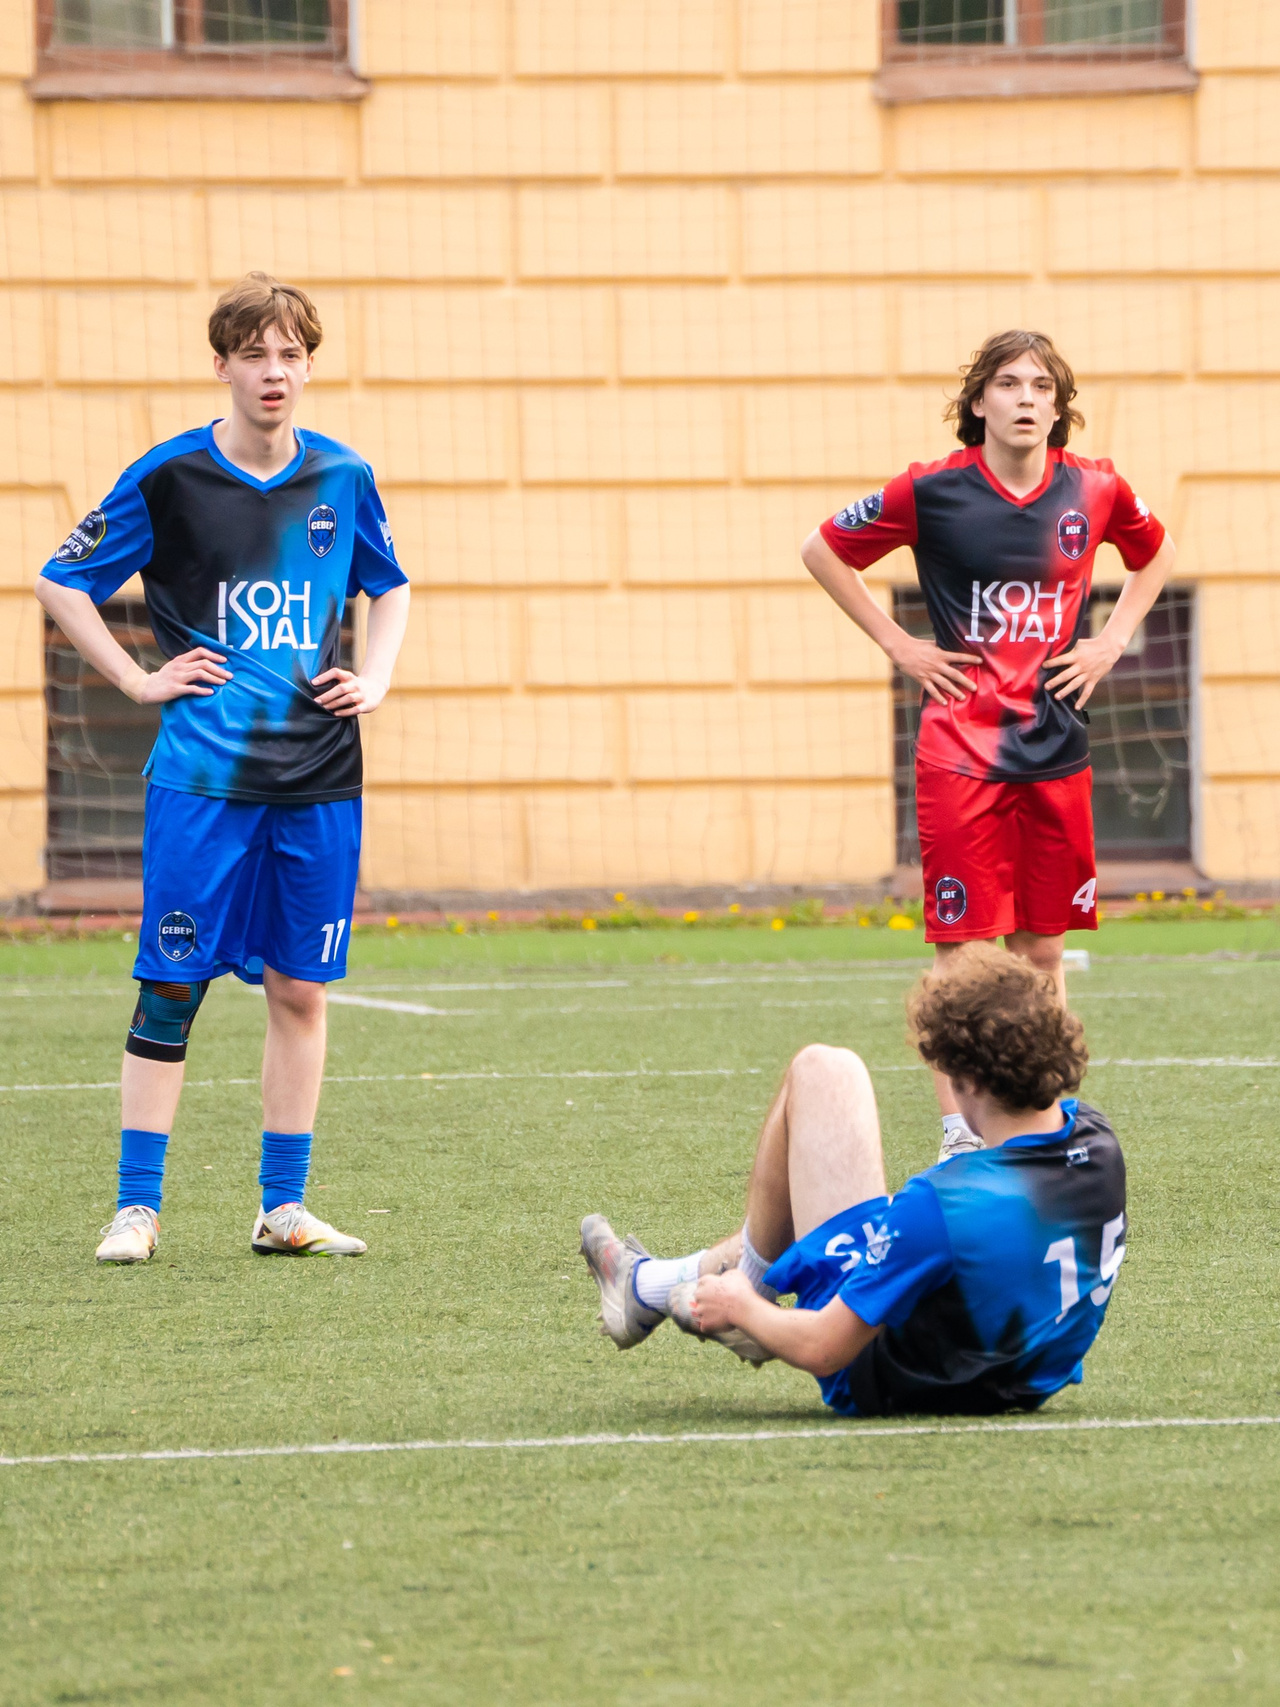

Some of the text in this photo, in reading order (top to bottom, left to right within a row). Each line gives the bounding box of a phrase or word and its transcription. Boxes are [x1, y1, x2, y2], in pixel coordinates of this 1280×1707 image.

[310, 519, 334, 531] СЕВЕР
[1072, 876, 1097, 914] 4
[161, 925, 193, 937] СЕВЕР
[320, 918, 347, 964] 11
[1042, 1209, 1127, 1325] 15
